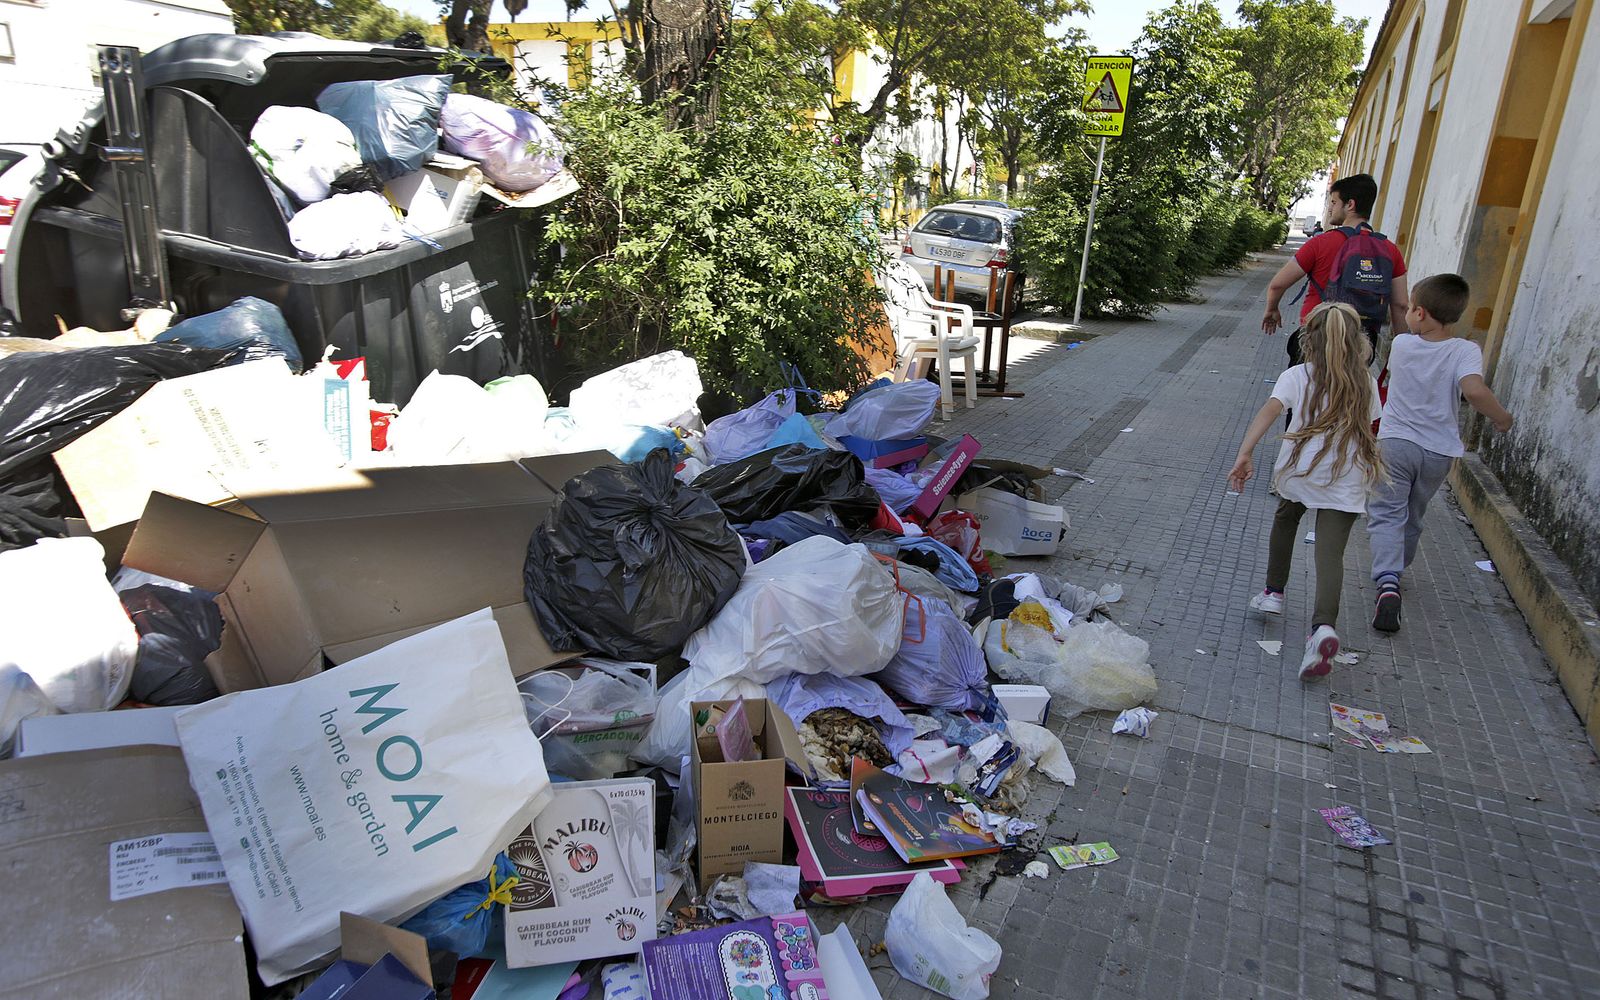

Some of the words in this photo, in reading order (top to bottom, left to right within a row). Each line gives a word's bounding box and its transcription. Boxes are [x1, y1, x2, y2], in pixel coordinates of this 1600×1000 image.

[1088, 61, 1131, 70] ATENCIÓN
[1083, 124, 1120, 132] ESCOLAR
[932, 451, 967, 496] Science4you
[1022, 526, 1052, 538] Roca
[320, 708, 350, 765] home
[573, 732, 640, 744] MERCADONA
[349, 682, 458, 852] MOAI
[340, 768, 362, 790] &
[290, 764, 326, 842] www.moai.es
[346, 792, 389, 857] garden
[704, 812, 778, 824] MONTELCIEGO
[543, 818, 612, 855] MALIBU
[116, 838, 163, 852] AM12BP
[731, 844, 750, 853] RIOJA
[517, 866, 551, 882] IBBEAN
[570, 878, 602, 894] CARIBBEAN
[572, 890, 587, 898] WITH
[588, 878, 614, 892] COCONUT
[582, 886, 608, 900] FLAVOUR
[605, 906, 648, 924] MALIBU
[517, 920, 570, 933] CARIBBEAN
[572, 918, 592, 926] RUM
[519, 932, 544, 941] WITH
[546, 926, 590, 937] COCONUT
[534, 936, 576, 947] FLAVOUR
